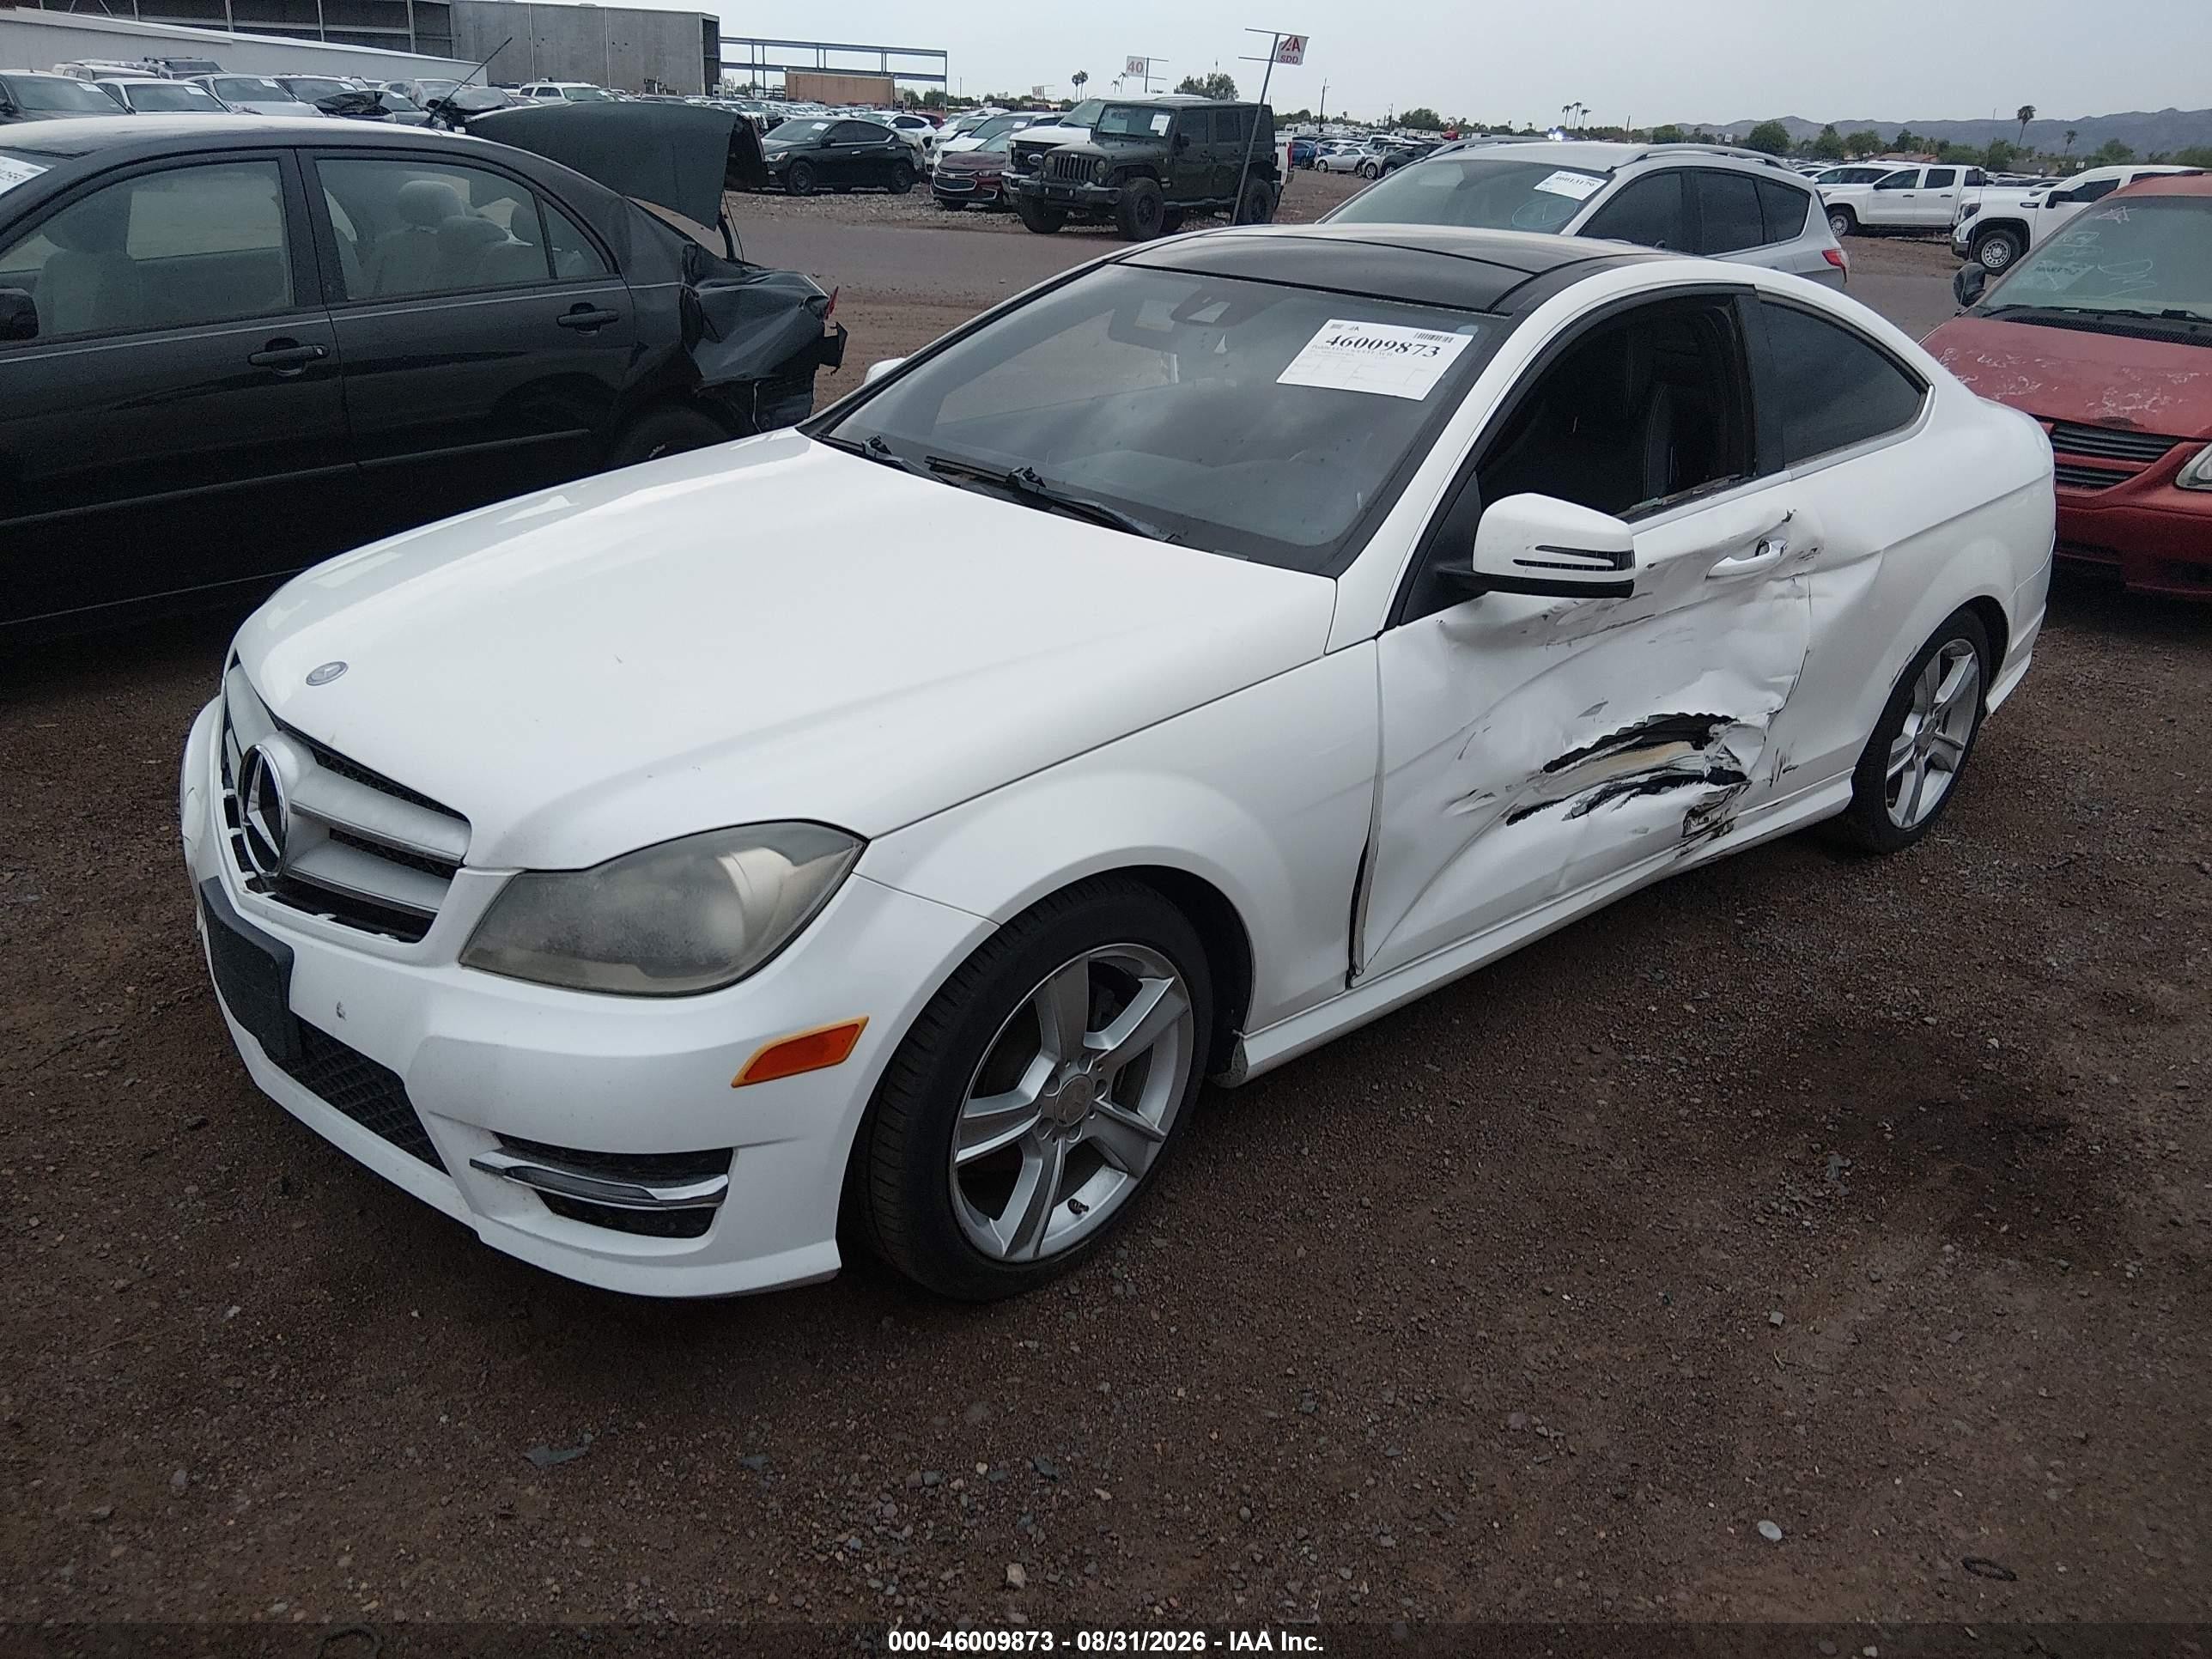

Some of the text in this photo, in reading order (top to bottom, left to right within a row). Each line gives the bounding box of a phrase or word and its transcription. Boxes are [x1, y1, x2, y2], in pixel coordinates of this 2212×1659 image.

[1279, 55, 1298, 64] SDD
[1127, 60, 1143, 74] 40
[1325, 333, 1441, 358] 46009873
